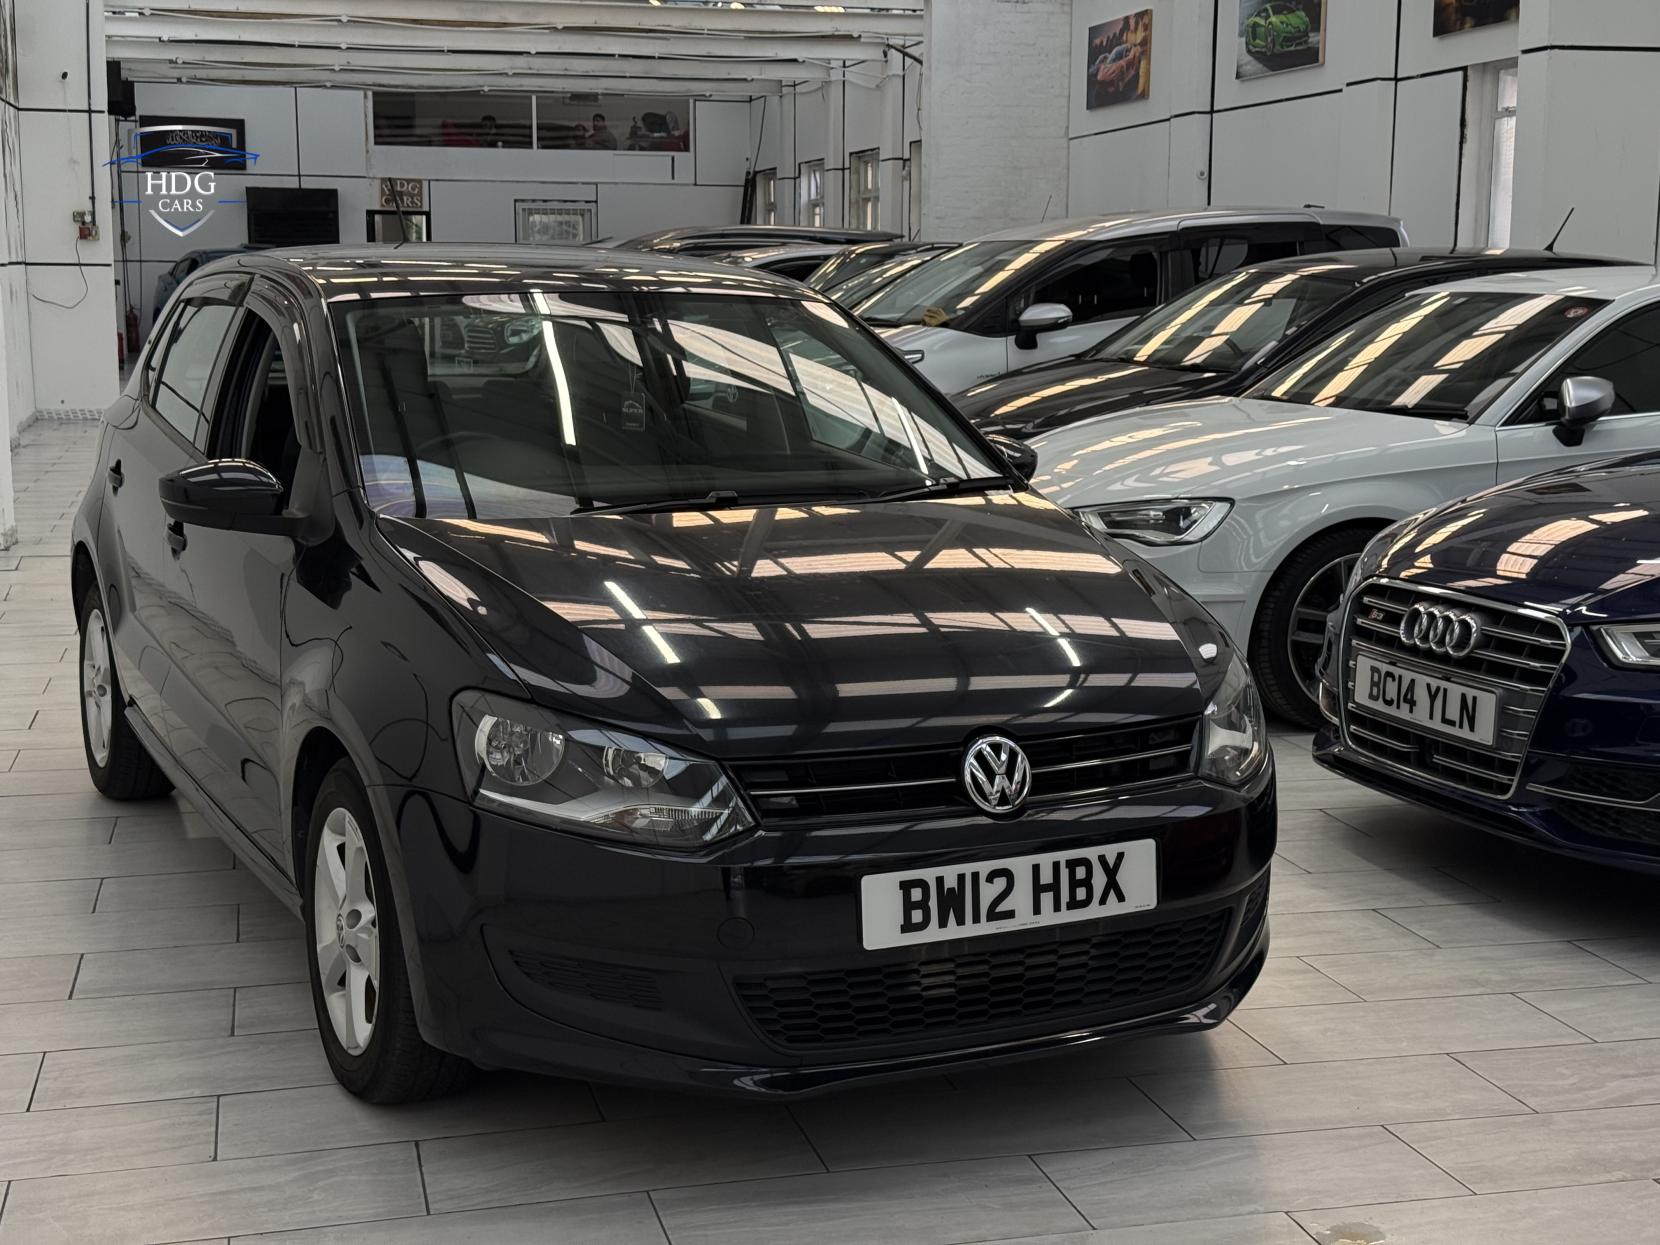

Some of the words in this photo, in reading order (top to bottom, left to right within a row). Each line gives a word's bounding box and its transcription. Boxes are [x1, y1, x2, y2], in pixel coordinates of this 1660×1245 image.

[1368, 665, 1416, 714] BC14
[1426, 682, 1478, 733] YLN
[898, 868, 1016, 934] BW12
[1032, 852, 1127, 915] HBX
